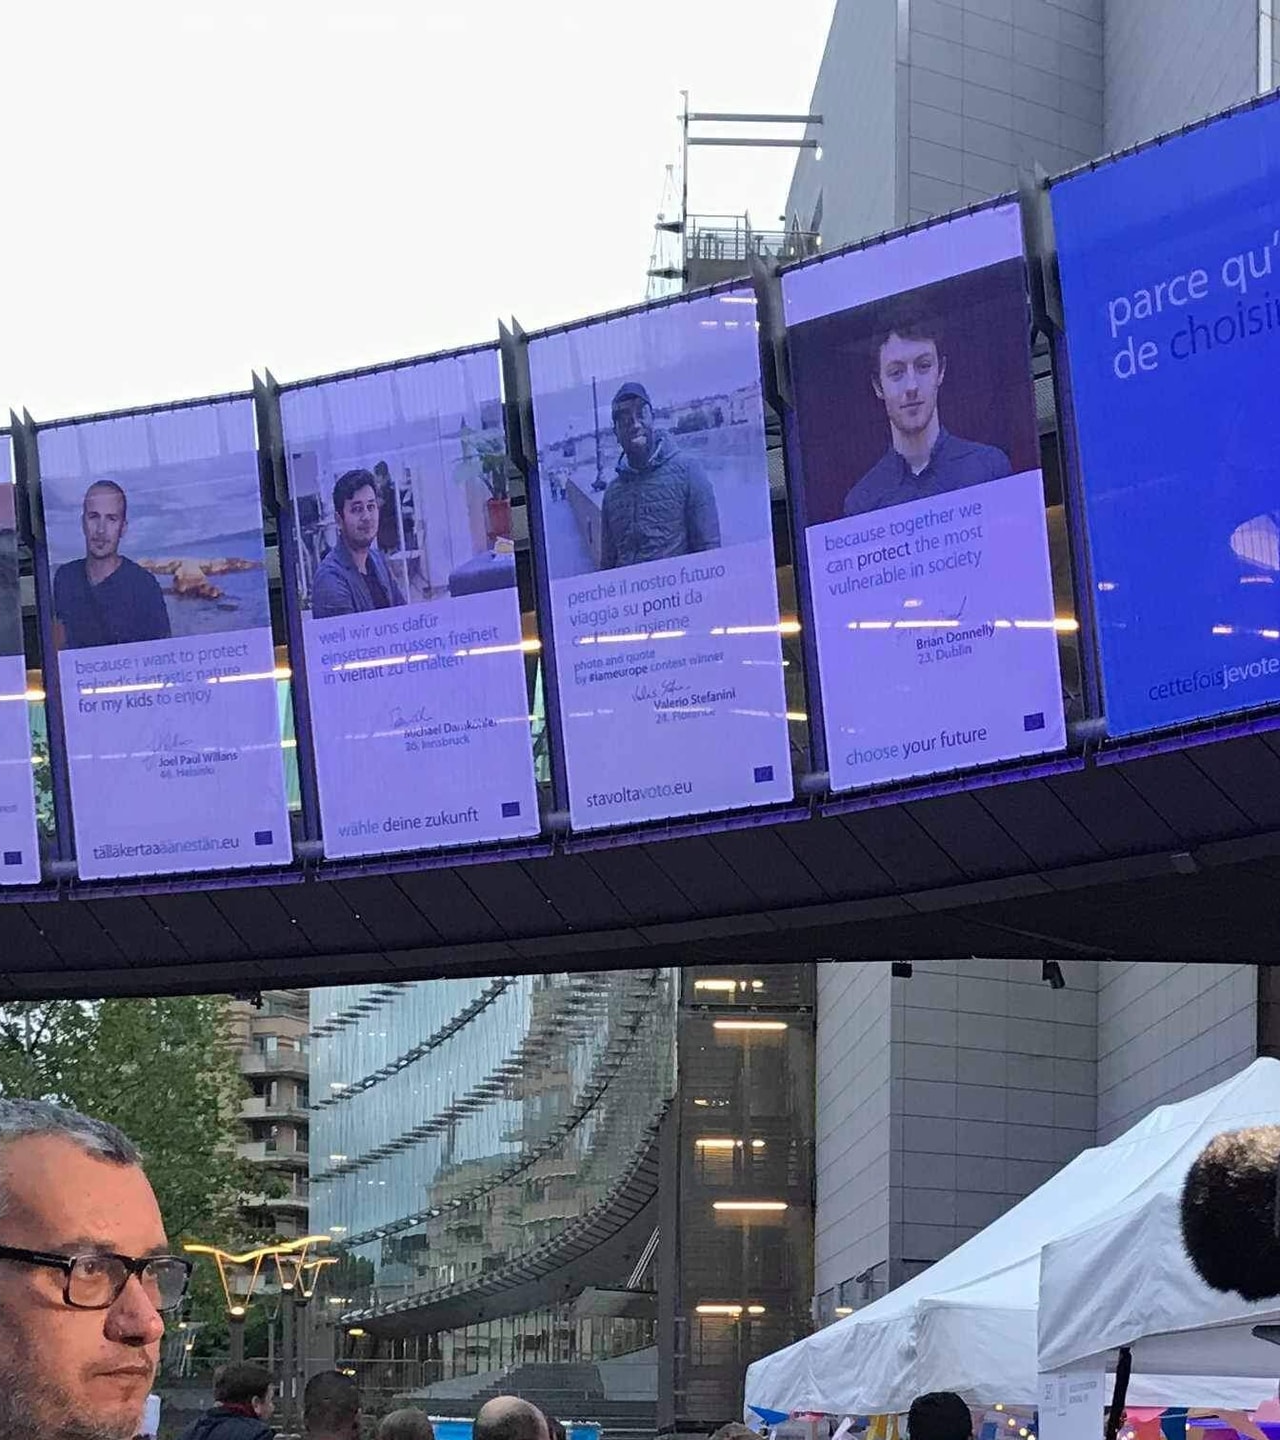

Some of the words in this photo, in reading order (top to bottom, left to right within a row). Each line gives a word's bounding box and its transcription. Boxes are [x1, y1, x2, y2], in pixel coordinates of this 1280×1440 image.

[1108, 268, 1209, 338] parce
[1113, 335, 1158, 379] de
[824, 526, 886, 551] because
[890, 509, 954, 535] together
[959, 502, 983, 518] we
[825, 558, 853, 575] can
[857, 542, 911, 570] protect
[915, 535, 940, 553] the
[944, 525, 984, 546] most
[568, 583, 616, 608] perché
[620, 583, 629, 596] il
[631, 574, 677, 594] nostro
[680, 564, 726, 584] futuro
[828, 568, 906, 596] vulnerable
[910, 562, 924, 578] in
[929, 549, 983, 575] society
[570, 603, 619, 627] viaggia
[623, 602, 639, 617] su
[642, 593, 681, 617] ponti
[685, 588, 703, 606] da
[319, 627, 346, 644] weil
[349, 624, 370, 640] wir
[375, 623, 399, 638] uns
[402, 614, 439, 634] dafür
[634, 614, 690, 635] insieme
[916, 635, 944, 650] Brian
[946, 623, 996, 644] Donnelly
[75, 657, 131, 674] because
[141, 652, 176, 667] want
[180, 650, 195, 663] to
[199, 644, 249, 664] protect
[321, 645, 386, 666] einsetzen
[449, 626, 500, 646] freiheit
[574, 657, 603, 673] photo
[606, 654, 624, 667] and
[626, 649, 655, 665] quote
[935, 644, 972, 661] Dublin
[323, 673, 336, 685] in
[339, 664, 384, 684] vielfalt
[387, 663, 404, 677] zu
[407, 654, 464, 675] erhalten
[575, 672, 587, 685] by
[650, 657, 687, 672] contest
[689, 651, 724, 665] winner
[78, 699, 98, 713] for
[101, 698, 123, 714] my
[126, 692, 153, 709] kids
[157, 693, 172, 706] to
[175, 687, 212, 706] enjoy
[654, 695, 689, 710] Valerio
[691, 687, 736, 705] Stefanini
[180, 754, 201, 766] Paul
[846, 742, 898, 766] choose
[902, 735, 936, 757] your
[940, 726, 987, 748] future
[586, 781, 693, 808] stavoltavoto.eu
[338, 820, 379, 837] wähle
[383, 816, 421, 833] deine
[425, 806, 479, 828] zukunft
